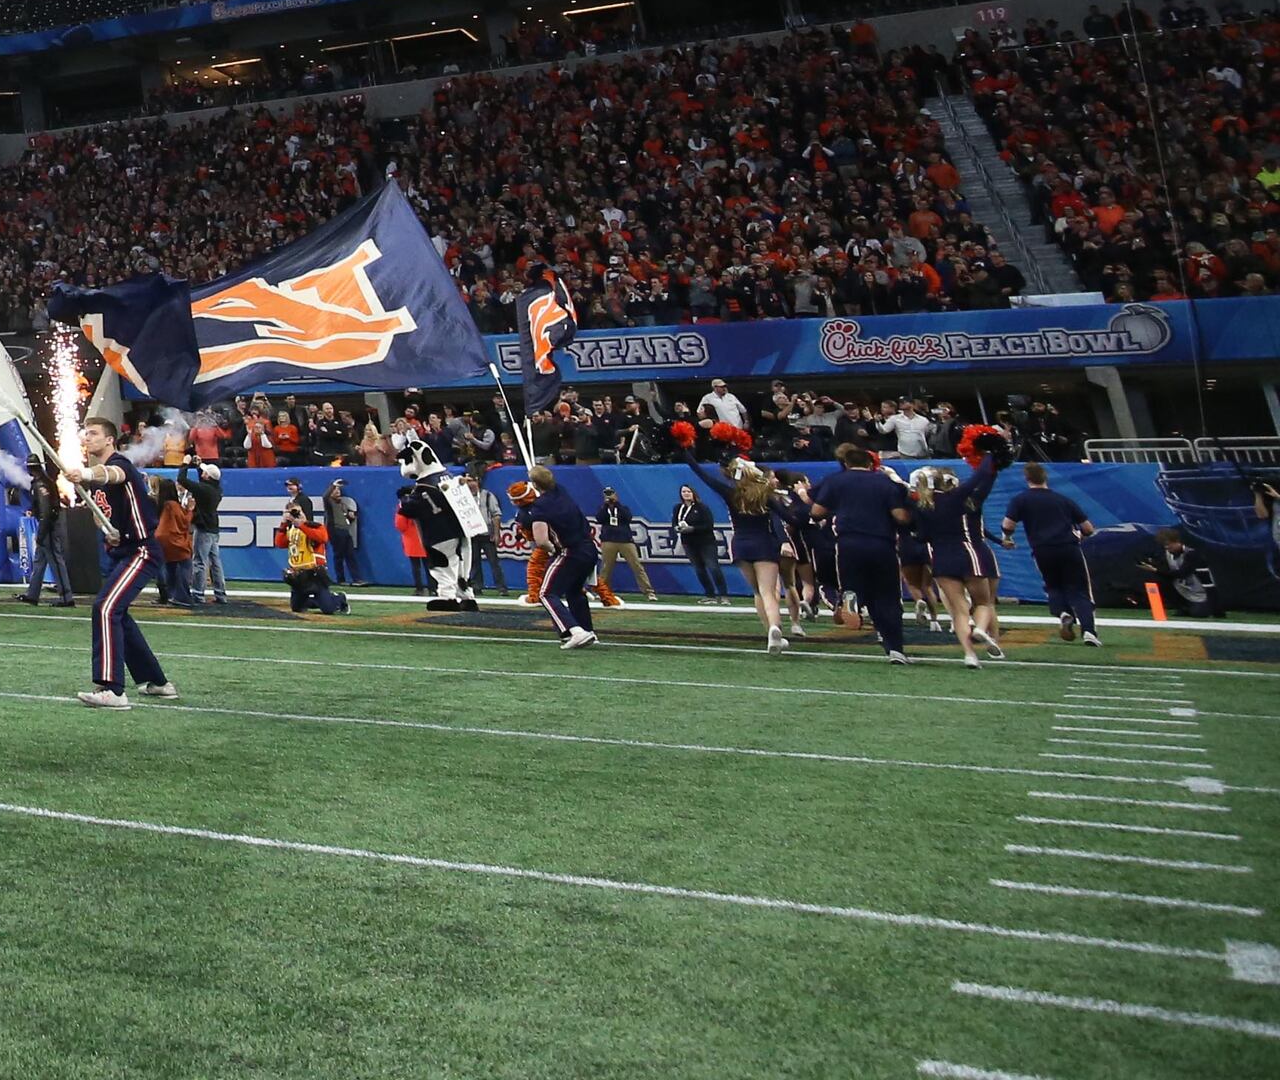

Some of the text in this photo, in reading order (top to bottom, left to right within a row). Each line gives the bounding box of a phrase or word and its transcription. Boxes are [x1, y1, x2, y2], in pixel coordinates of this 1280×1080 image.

[977, 7, 1006, 21] 119
[498, 333, 705, 368] 5 YEARS
[825, 320, 1140, 363] Chick-fil-A PEACH BOWL
